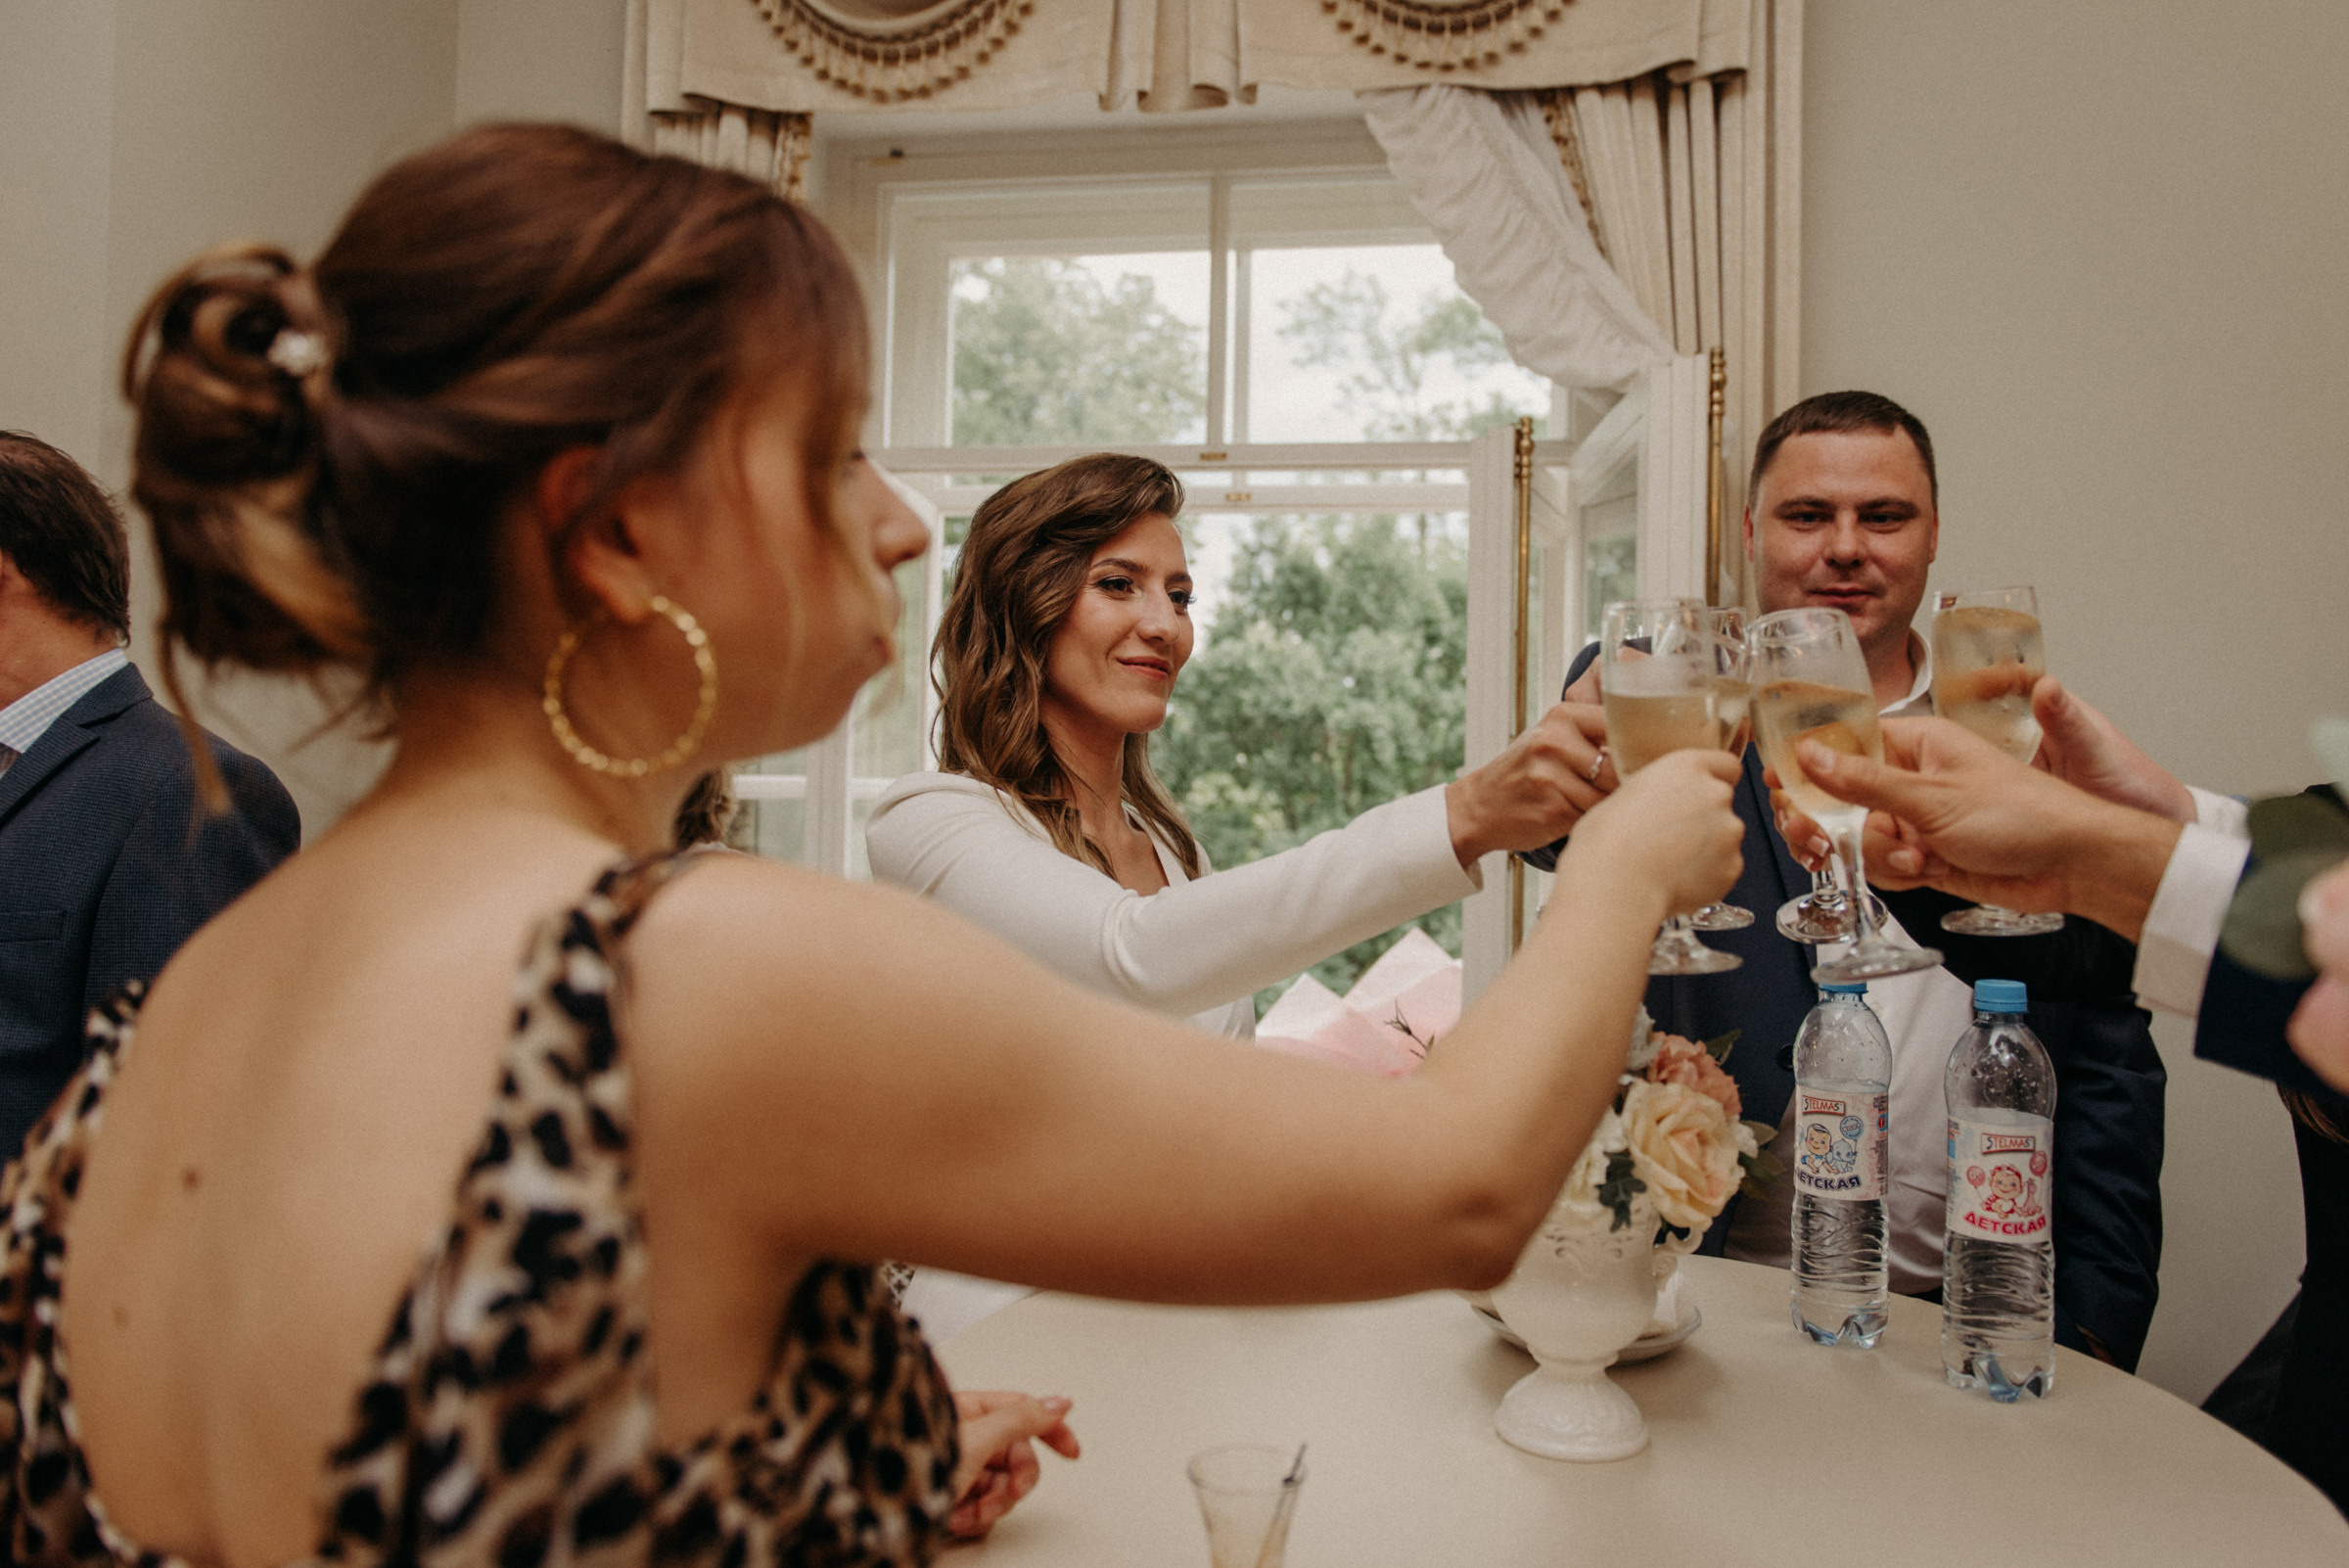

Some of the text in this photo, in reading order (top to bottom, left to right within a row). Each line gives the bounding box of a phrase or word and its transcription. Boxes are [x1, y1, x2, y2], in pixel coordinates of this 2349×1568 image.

[1804, 1097, 1840, 1111] STELMAS
[1987, 1136, 2031, 1150] STELMAS
[1797, 1169, 1861, 1190] ЕТСКАЯ
[1963, 1211, 2047, 1235] ДЕТСКАЯ
